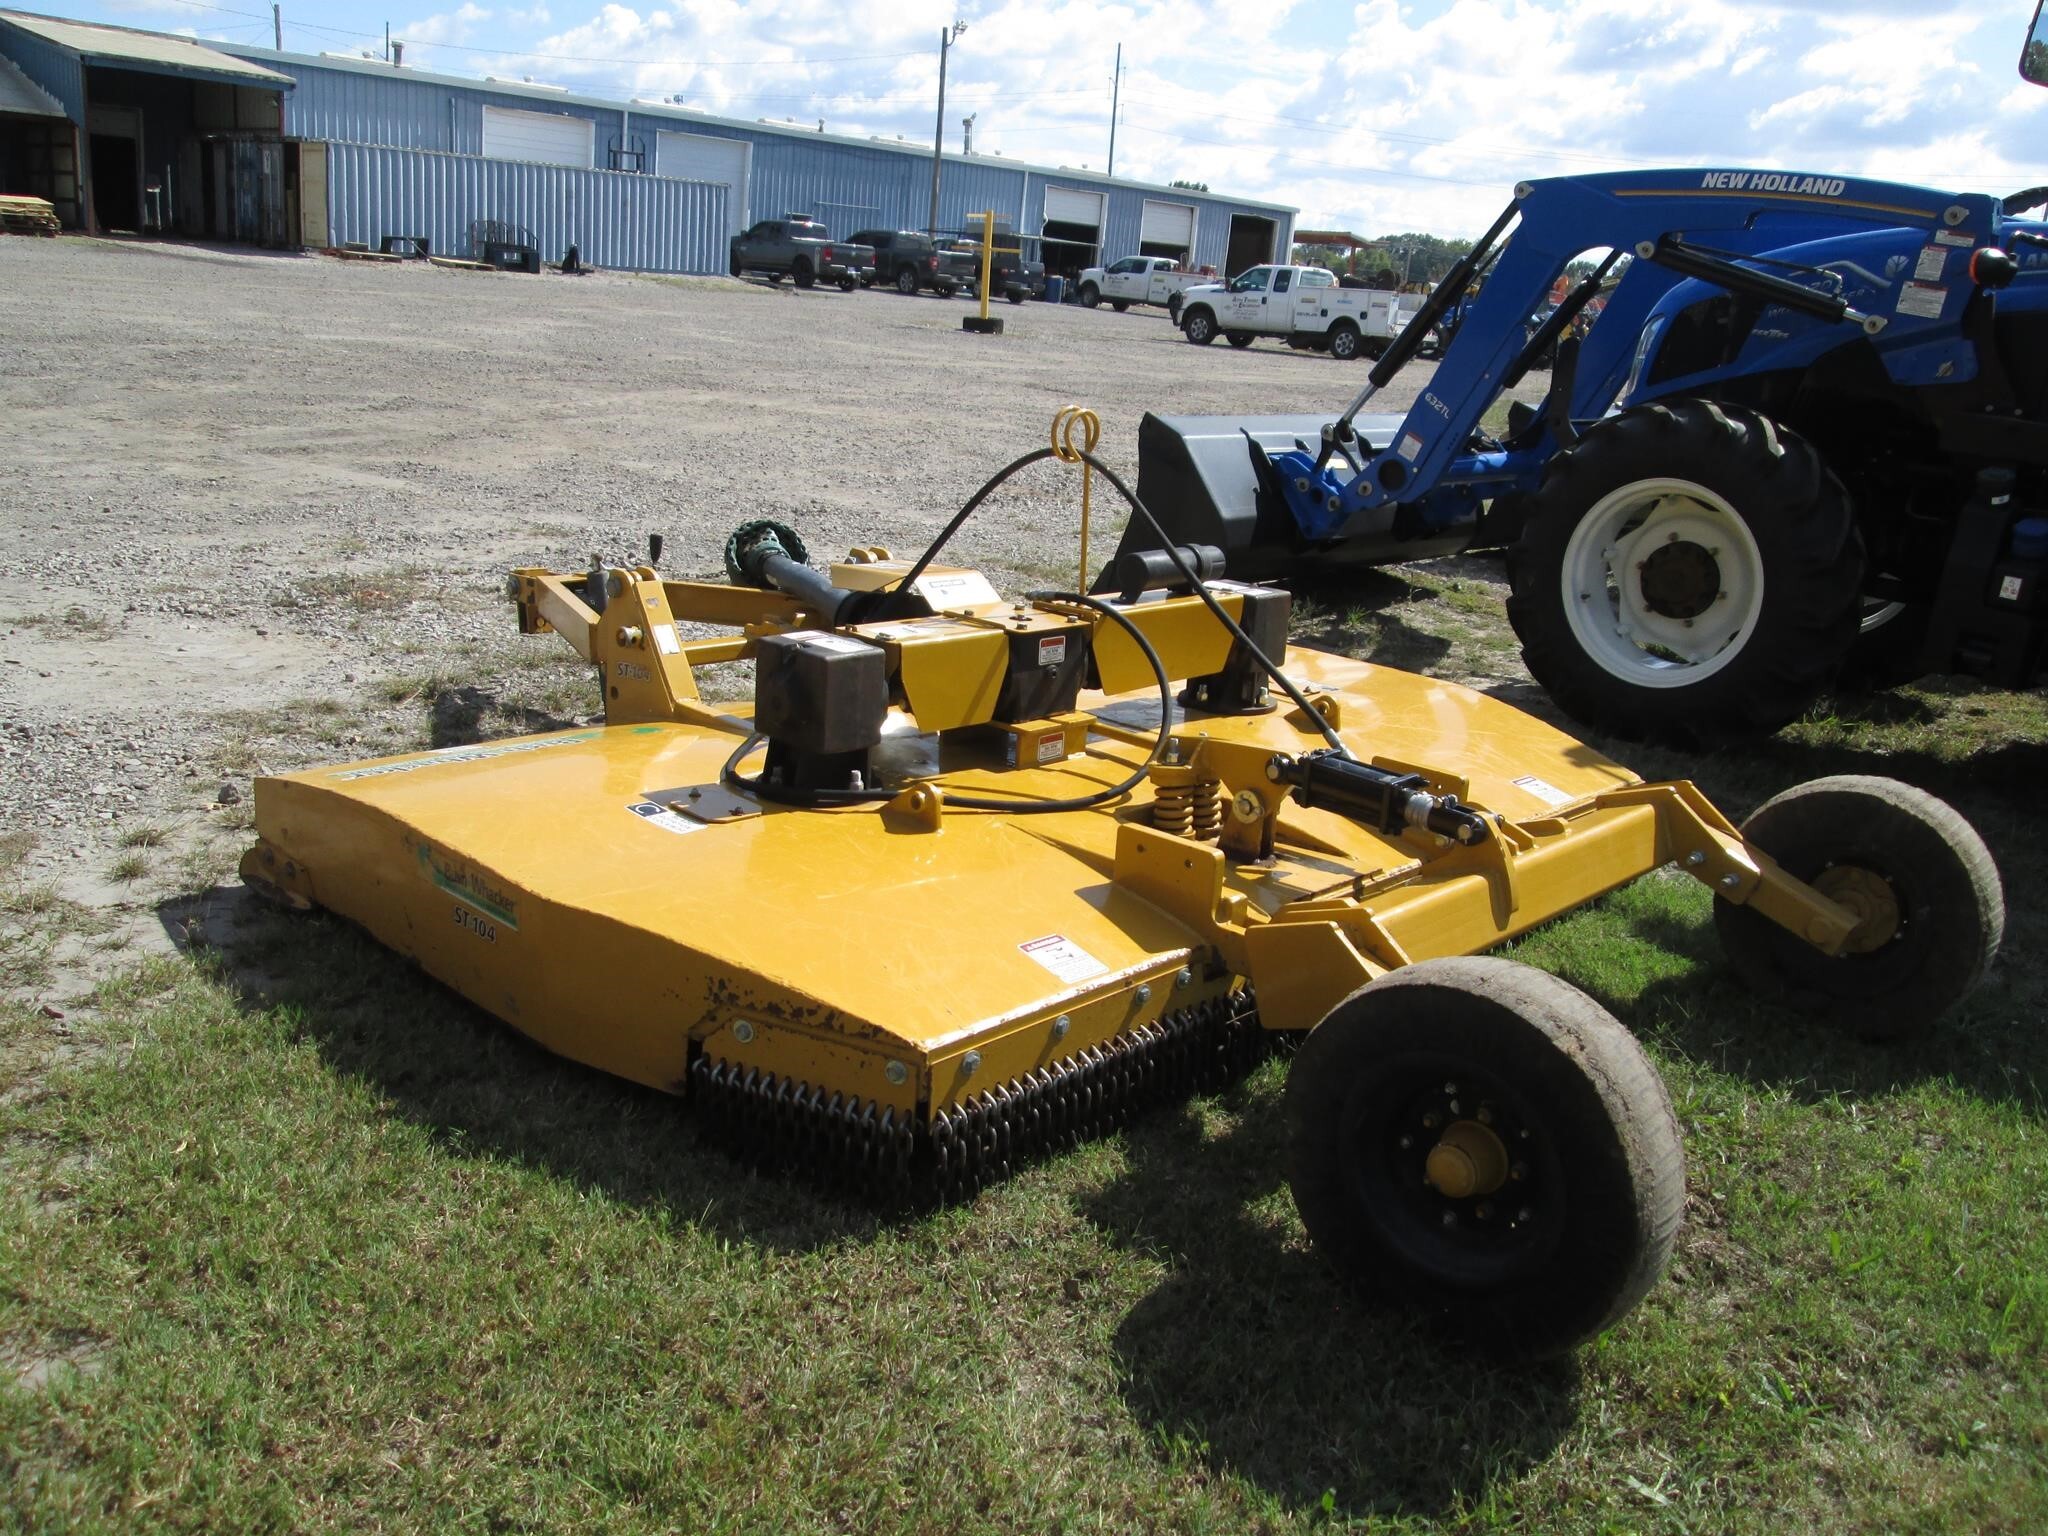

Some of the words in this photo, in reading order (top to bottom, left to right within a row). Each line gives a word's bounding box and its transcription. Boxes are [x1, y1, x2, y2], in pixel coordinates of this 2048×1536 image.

[1701, 172, 1750, 189] NEW
[1750, 173, 1846, 196] HOLLAND
[1425, 392, 1451, 419] 632TL
[455, 905, 470, 928] ST
[473, 916, 497, 943] 104
